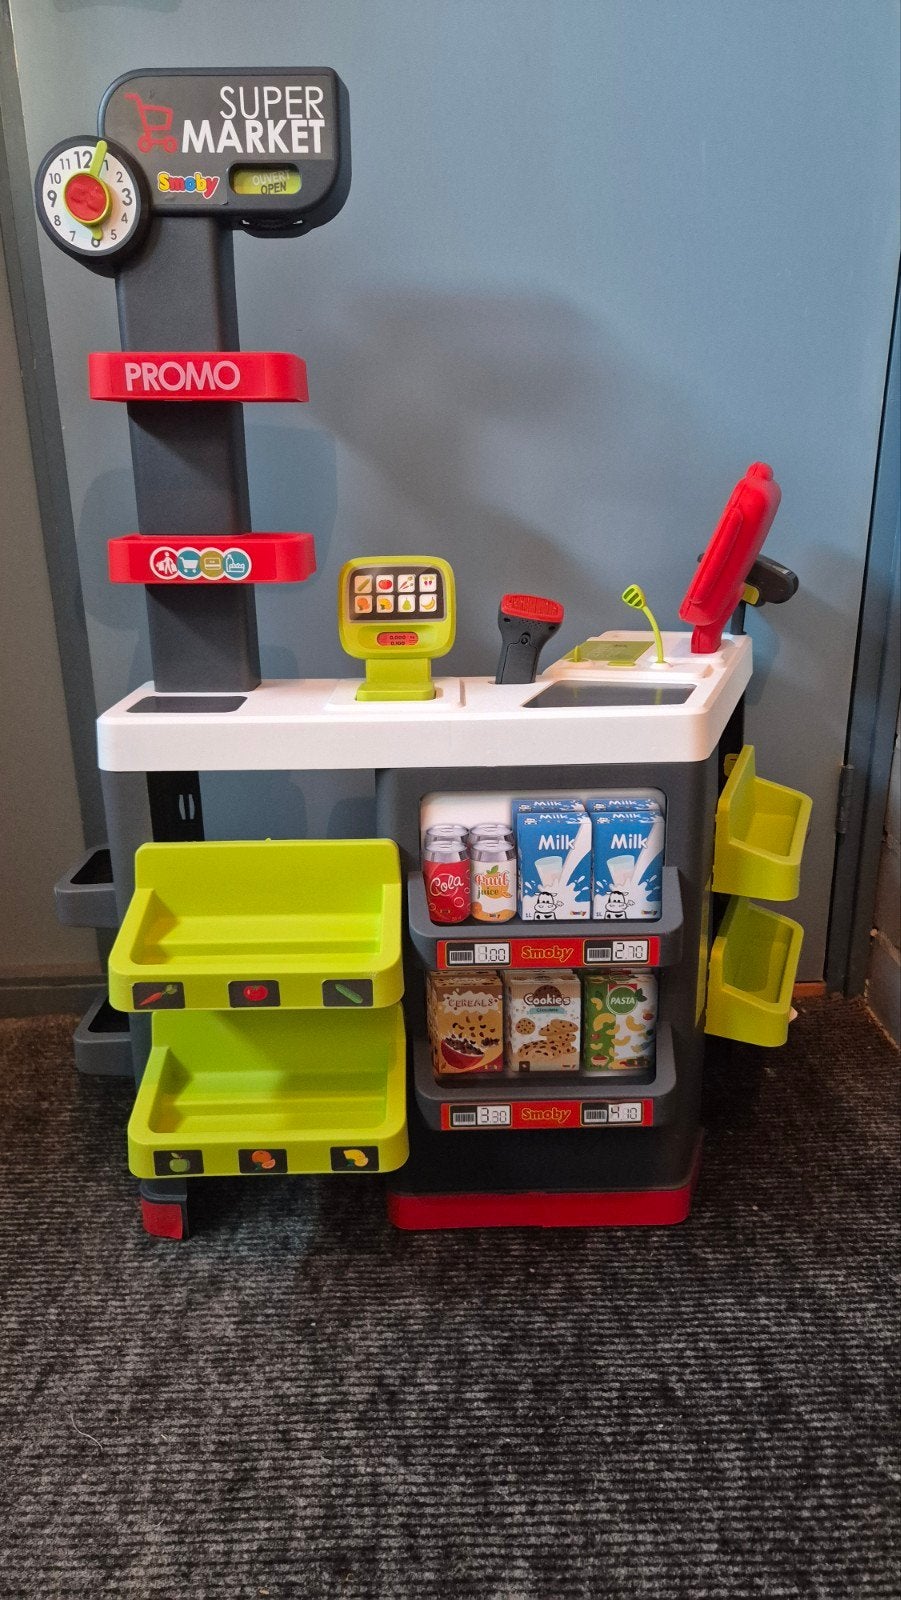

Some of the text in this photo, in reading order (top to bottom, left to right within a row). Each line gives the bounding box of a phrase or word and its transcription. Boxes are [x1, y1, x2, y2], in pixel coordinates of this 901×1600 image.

[219, 85, 324, 120] SUPER
[181, 119, 326, 154] MARKET
[59, 158, 71, 170] 11
[74, 150, 93, 169] 12
[48, 172, 62, 184] 10
[116, 171, 124, 183] 2
[157, 170, 220, 200] Smoby
[252, 170, 290, 186] OUVERT
[260, 181, 287, 195] OPEN
[47, 189, 58, 208] 9
[121, 187, 133, 206] 3
[53, 214, 62, 227] 8
[121, 212, 129, 224] 4
[69, 230, 77, 242] 7
[110, 229, 118, 241] 5
[124, 360, 241, 391] PROMO
[538, 834, 576, 851] Milk
[610, 833, 649, 850] Milk
[430, 875, 465, 897] Cola
[475, 871, 509, 887] Fruit
[476, 887, 499, 900] juice
[521, 945, 575, 963] Smoby
[614, 942, 644, 959] 2.70
[448, 998, 494, 1008] CEREALS
[609, 997, 637, 1006] PASTA
[481, 1107, 507, 1123] 3.30
[521, 1107, 572, 1123] Smoby
[610, 1106, 637, 1121] 4.10
